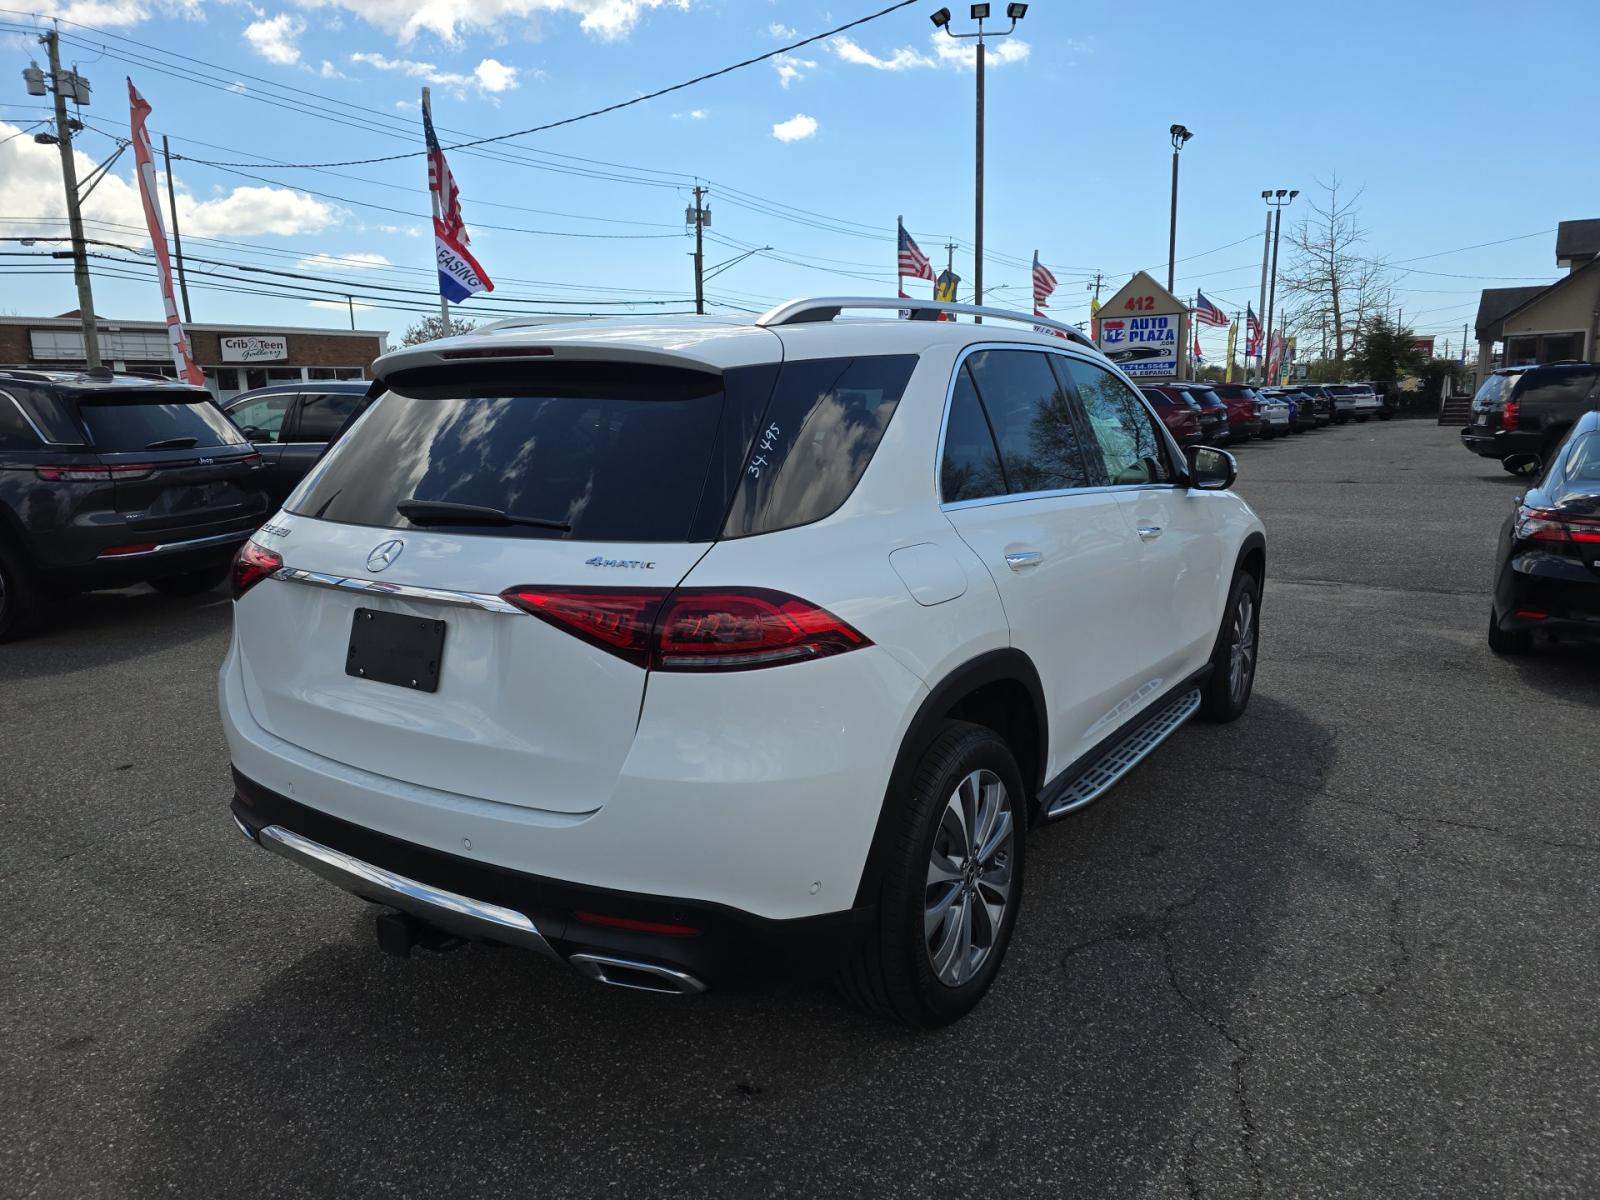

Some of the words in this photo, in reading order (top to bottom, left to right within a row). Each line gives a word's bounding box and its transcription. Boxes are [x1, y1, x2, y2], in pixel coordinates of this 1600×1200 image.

[1124, 296, 1155, 311] 412
[1130, 317, 1169, 330] AUTO
[1102, 329, 1126, 340] 112
[1129, 329, 1175, 343] PLAZA
[584, 556, 656, 570] 4MATIC
